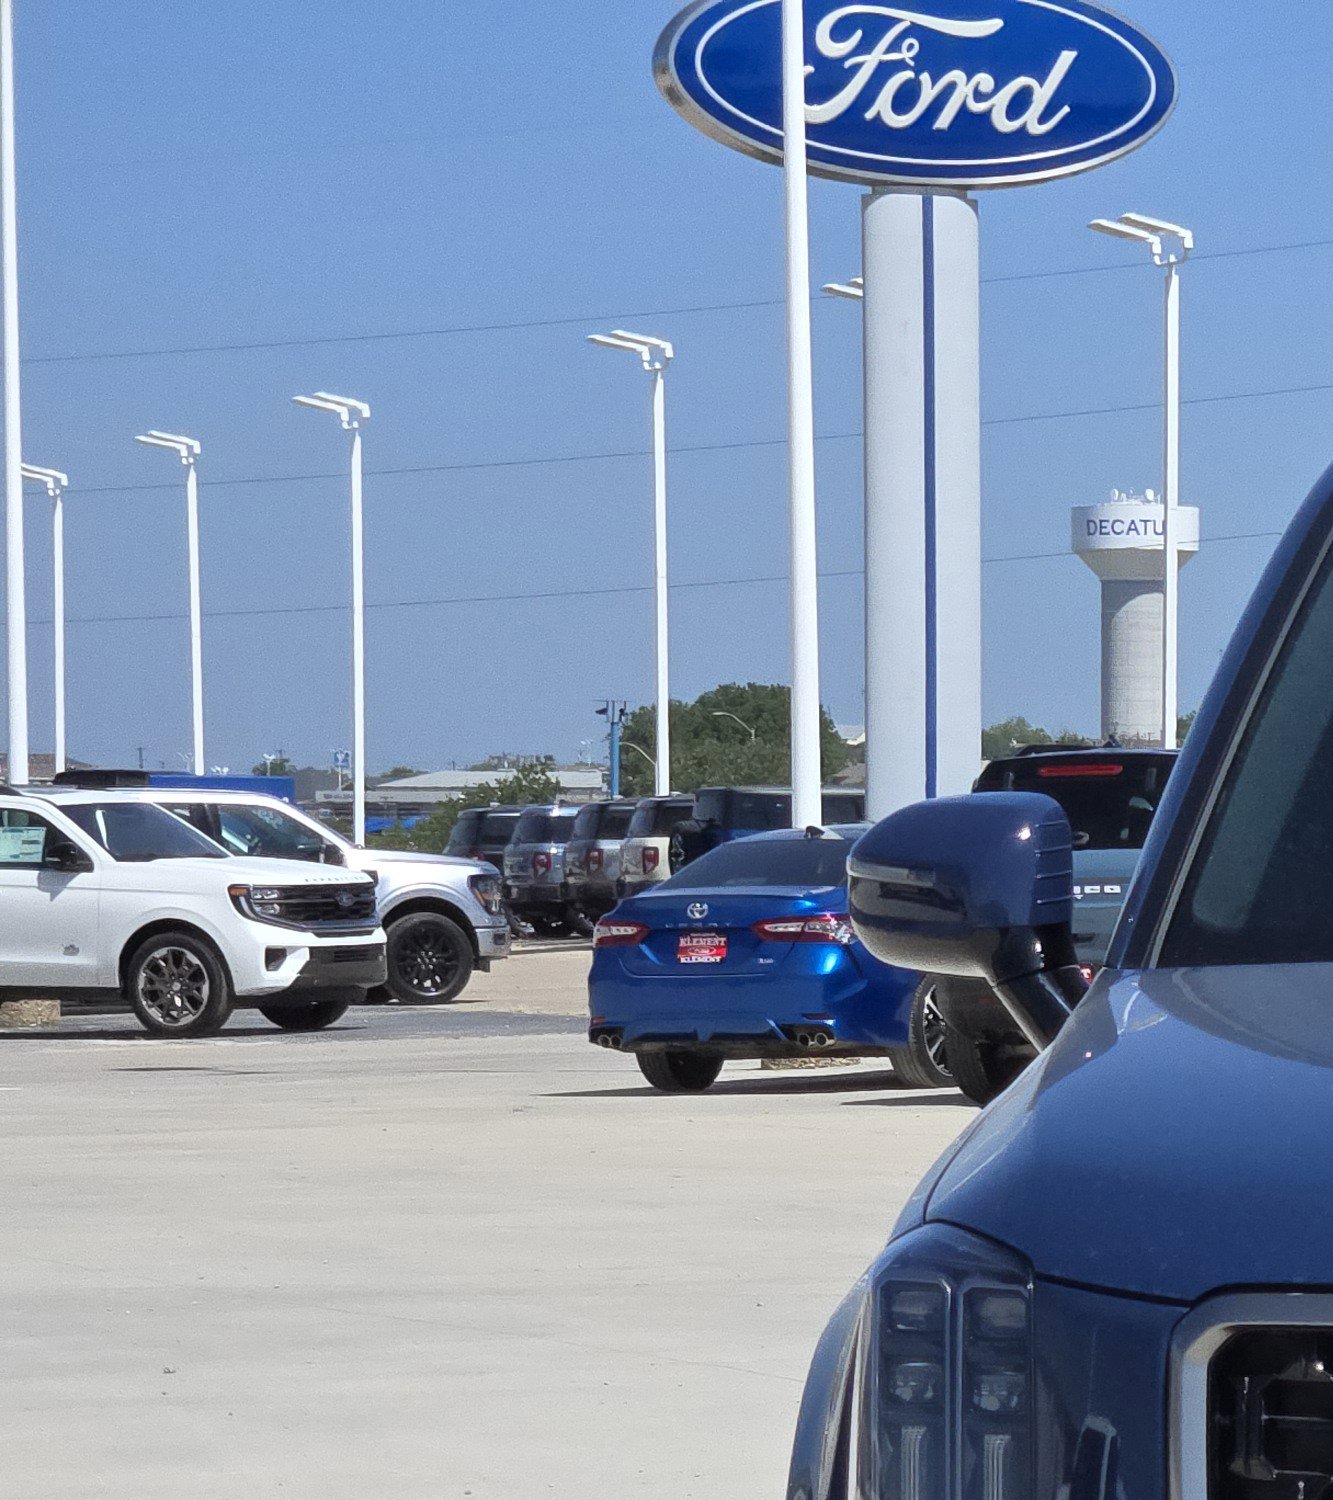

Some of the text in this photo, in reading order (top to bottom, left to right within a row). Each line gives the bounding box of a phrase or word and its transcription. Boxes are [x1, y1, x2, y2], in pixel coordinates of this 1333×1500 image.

[800, 4, 1078, 135] Ford
[1087, 519, 1166, 536] DECATU
[679, 936, 728, 947] KLEMENT
